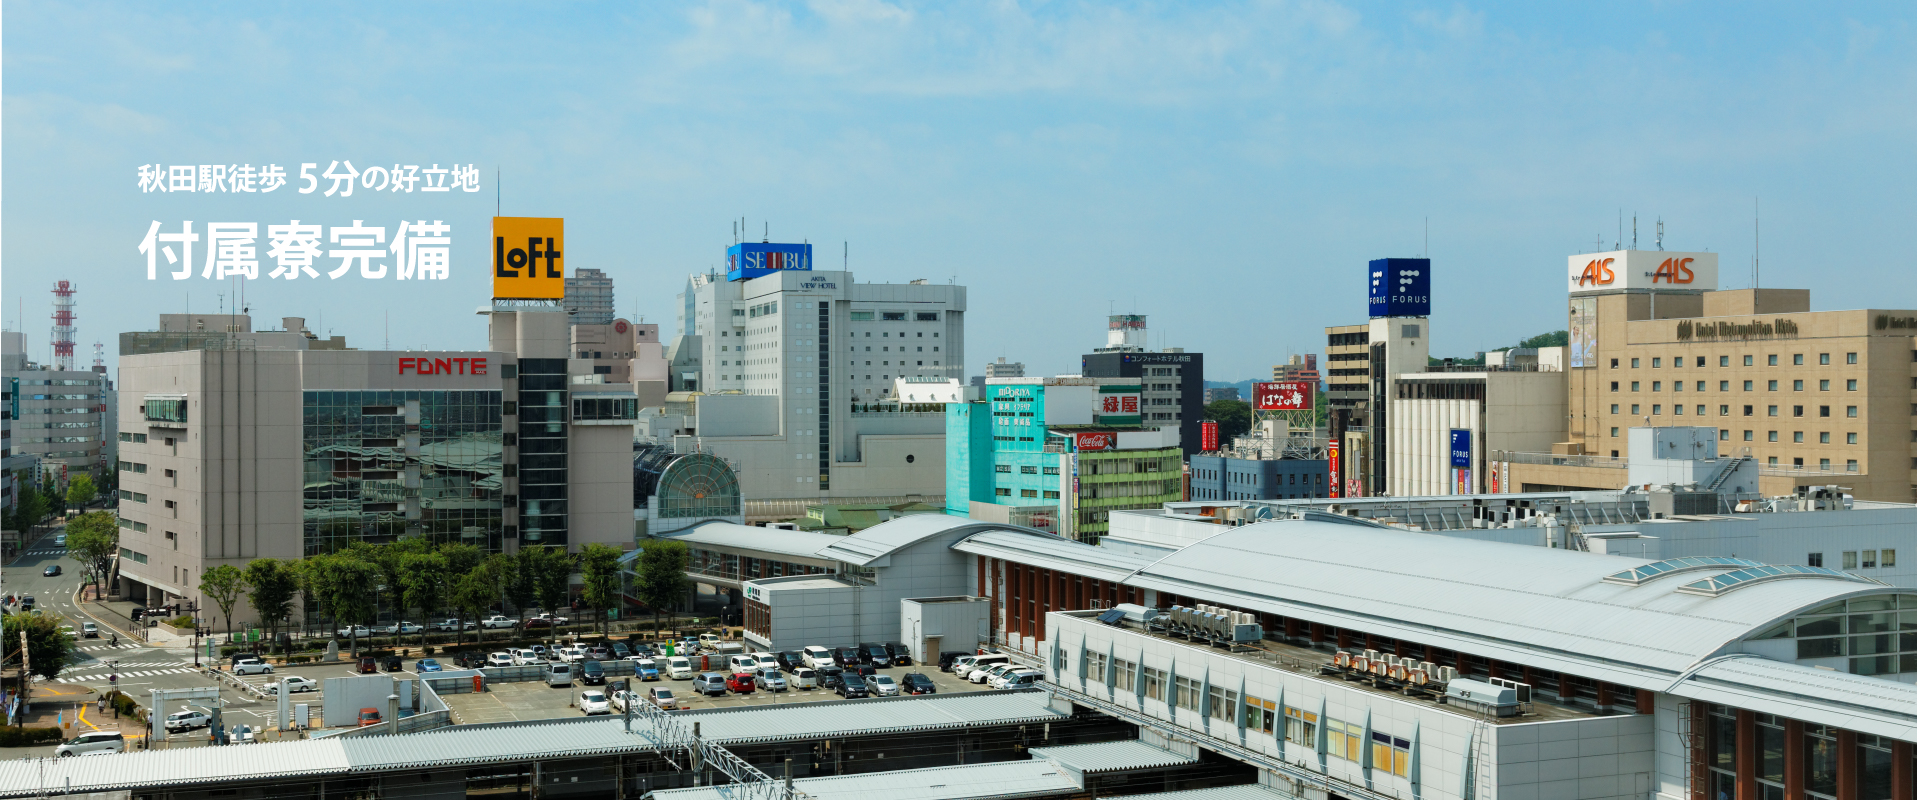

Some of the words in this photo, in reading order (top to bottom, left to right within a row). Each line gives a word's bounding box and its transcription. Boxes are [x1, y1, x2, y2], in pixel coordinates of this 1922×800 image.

[1370, 296, 1386, 304] FORUS
[1392, 295, 1427, 303] FORUS
[399, 358, 486, 374] FONTE
[1103, 396, 1138, 413] 緑屋
[1452, 450, 1469, 459] FORUS
